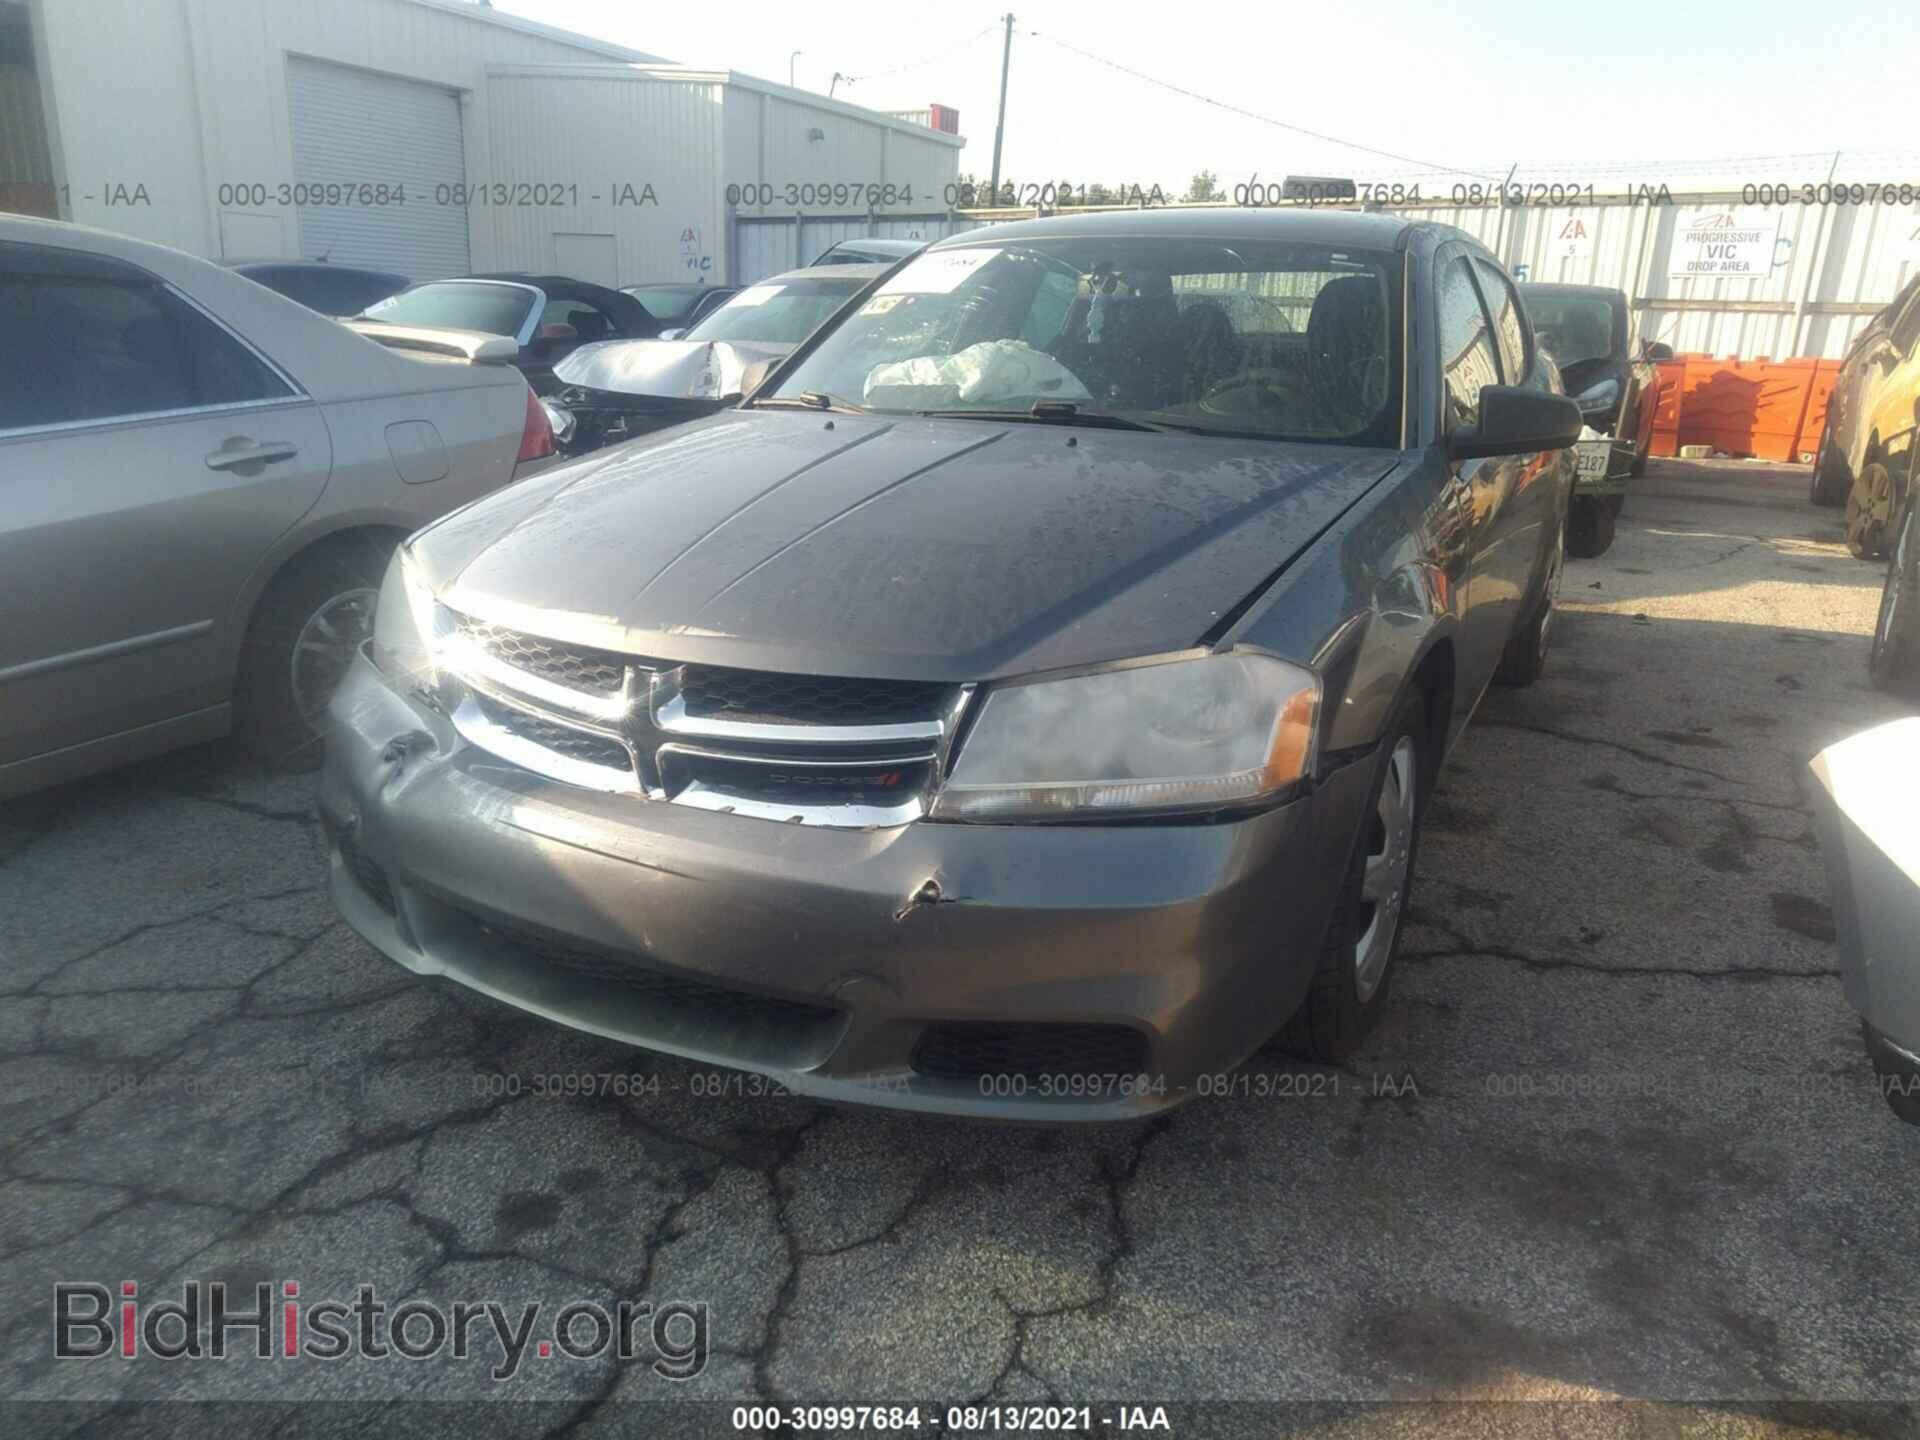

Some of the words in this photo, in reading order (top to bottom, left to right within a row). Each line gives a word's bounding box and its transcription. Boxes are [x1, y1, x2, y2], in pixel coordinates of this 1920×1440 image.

[1686, 231, 1762, 243] PROGRESSIVE
[1707, 244, 1737, 260] VIC
[1687, 261, 1718, 272] DROP
[1720, 261, 1750, 272] AREA
